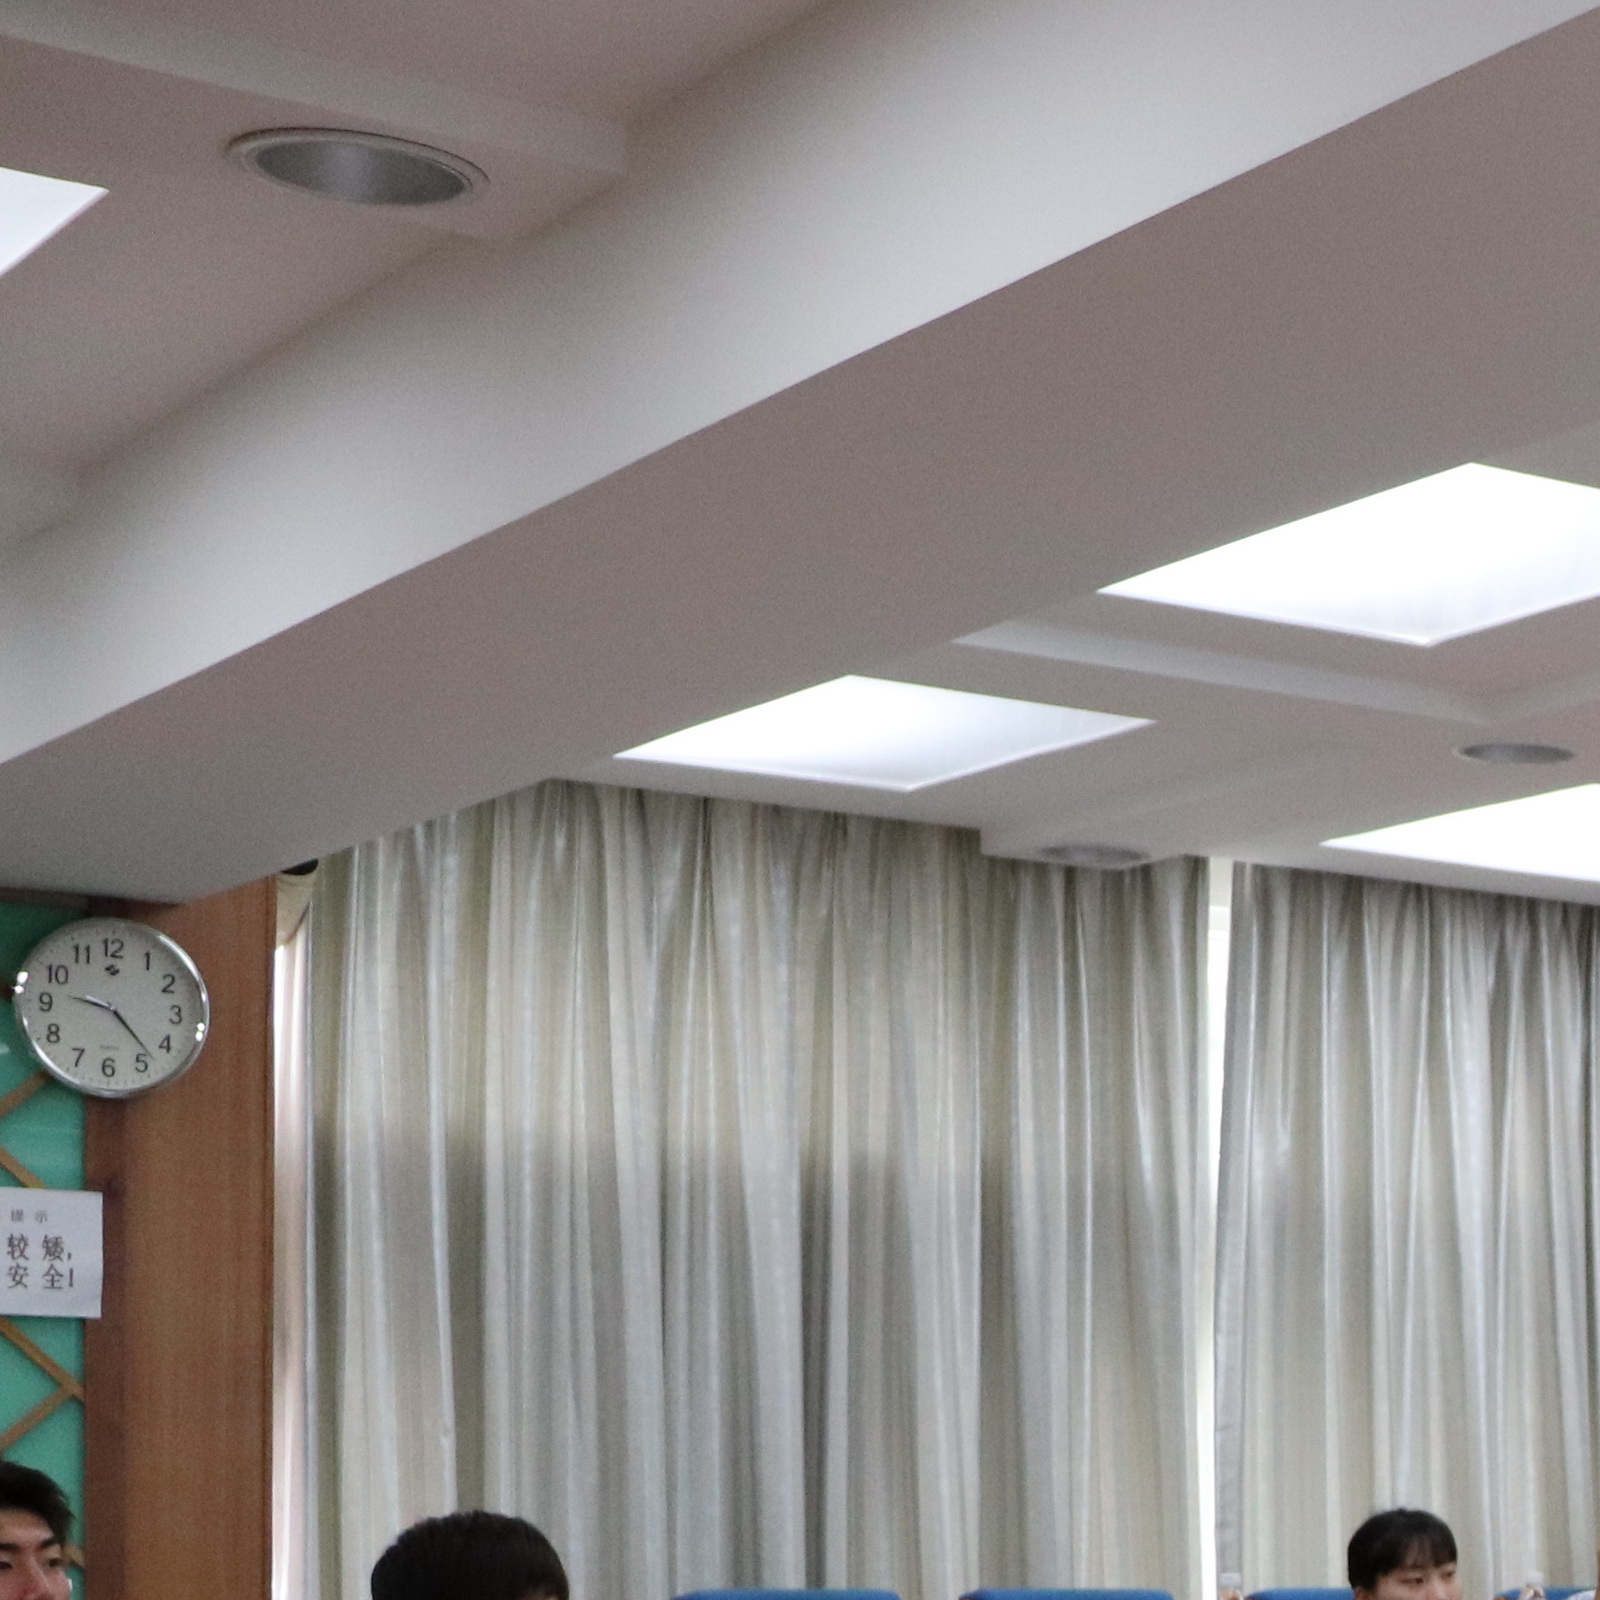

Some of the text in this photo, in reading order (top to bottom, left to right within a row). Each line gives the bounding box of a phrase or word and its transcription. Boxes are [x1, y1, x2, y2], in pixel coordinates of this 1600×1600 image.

[74, 944, 91, 964] 11
[102, 938, 124, 959] 12
[144, 952, 151, 971] 1
[47, 964, 69, 985] 10
[161, 973, 176, 994] 2
[39, 992, 53, 1012] 9
[169, 1005, 182, 1025] 3
[46, 1023, 61, 1043] 8
[158, 1034, 171, 1053] 4
[71, 1048, 86, 1067] 7
[101, 1057, 115, 1077] 6
[134, 1053, 149, 1073] 5
